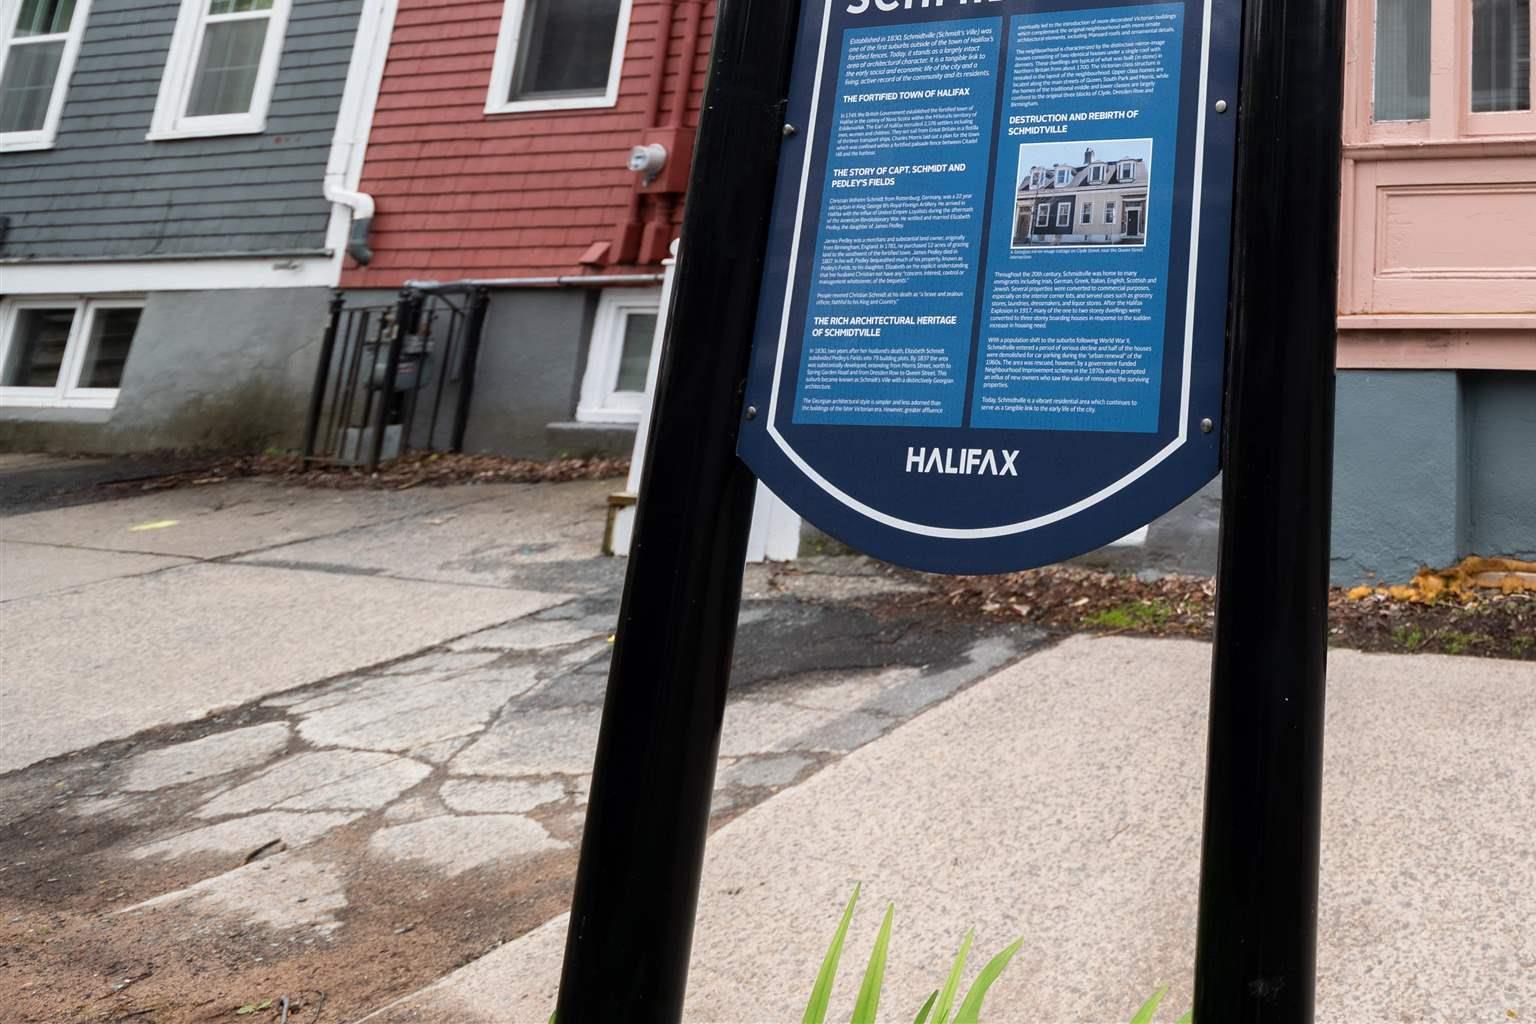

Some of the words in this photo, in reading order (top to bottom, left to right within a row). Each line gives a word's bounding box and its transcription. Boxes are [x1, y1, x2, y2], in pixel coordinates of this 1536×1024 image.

[850, 36, 881, 44] Established
[887, 34, 904, 44] 1830,
[903, 32, 936, 41] Schmidtville
[936, 30, 965, 40] (Schmidt's
[966, 29, 980, 38] Ville)
[889, 50, 907, 59] Today,
[943, 46, 962, 55] largely
[866, 59, 901, 67] architectural
[901, 57, 929, 65] character.
[944, 54, 968, 64] tangible
[855, 69, 869, 78] early
[950, 63, 961, 71] city
[844, 78, 860, 87] living,
[912, 73, 944, 82] community
[843, 95, 858, 103] THE
[859, 93, 898, 102] FORTIFIED
[899, 91, 924, 99] TOWN
[925, 90, 936, 98] OF
[937, 88, 970, 97] HALIFAX
[1009, 114, 1068, 124] DESTRUCTION
[1068, 113, 1088, 121] AND
[1088, 111, 1125, 120] REBIRTH
[1126, 110, 1139, 118] OF
[1008, 125, 1068, 136] SCHMIDTVILLE
[849, 168, 875, 176] STORY
[876, 167, 888, 175] OF
[888, 166, 911, 174] CAPT.
[912, 165, 948, 173] SCHMIDT
[948, 164, 966, 172] AND
[832, 179, 868, 188] PEDLEY'S
[868, 178, 896, 186] FIELDS
[814, 317, 831, 325] THE
[830, 317, 849, 325] RICH
[849, 316, 916, 325] ARCHITECTURAL
[917, 316, 957, 324] HERITAGE
[812, 329, 825, 337] OF
[824, 329, 881, 337] SCHMIDTVILLE
[905, 447, 1020, 476] HALIFAX
